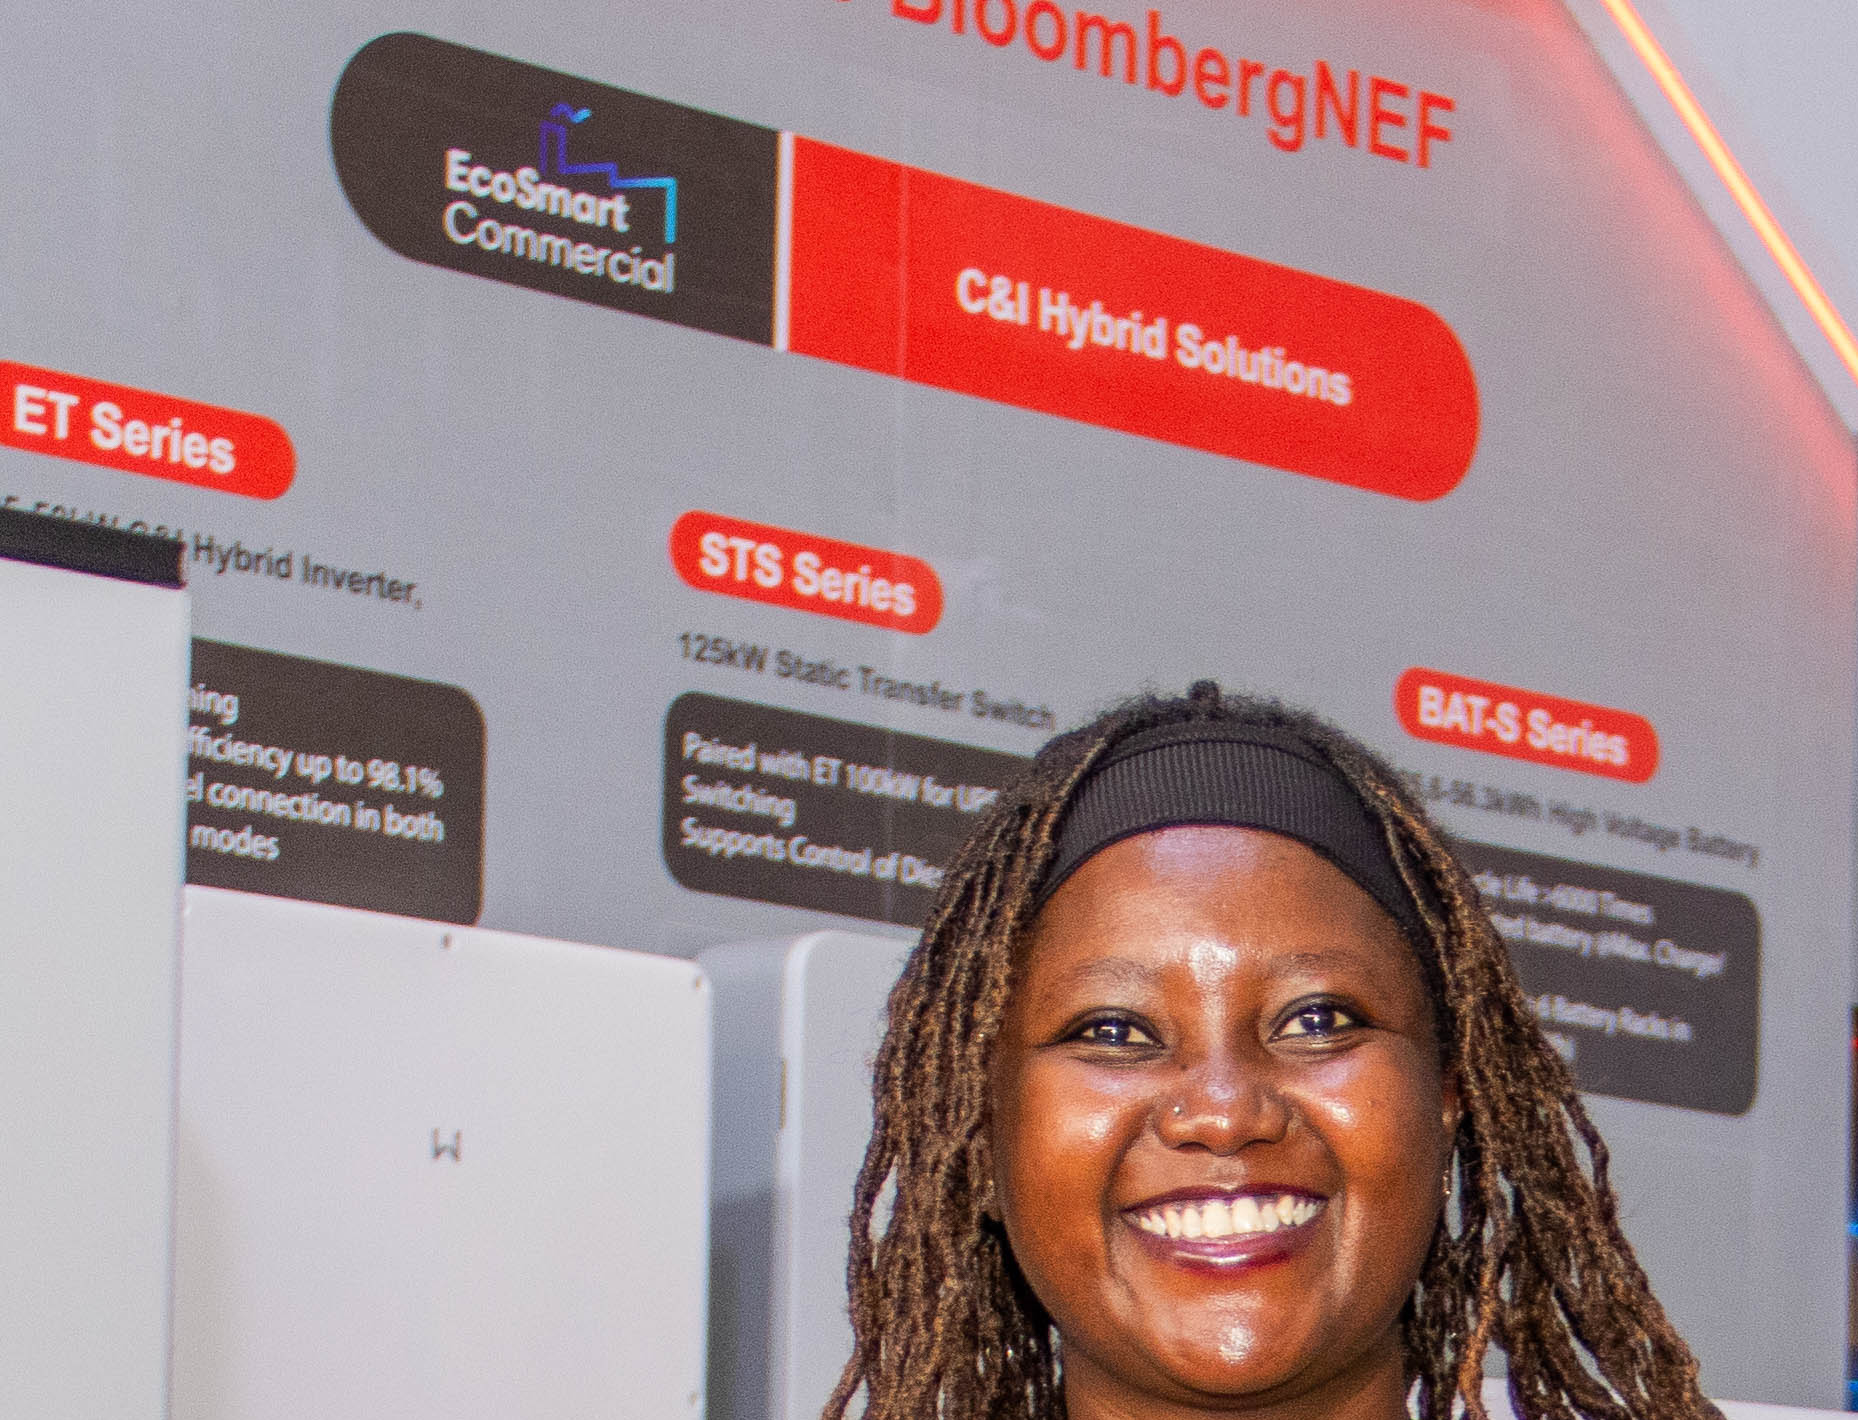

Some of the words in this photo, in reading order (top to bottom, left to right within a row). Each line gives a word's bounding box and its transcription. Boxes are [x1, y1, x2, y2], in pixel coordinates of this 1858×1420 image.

[891, 0, 1457, 169] oombergNEF
[444, 147, 630, 233] EcoSmart
[443, 200, 676, 294] Commercial
[956, 268, 1030, 326] C&I
[1038, 288, 1168, 361] Hybrid
[1177, 323, 1354, 407] Solutions
[13, 384, 79, 439] ET
[90, 401, 237, 475] Series
[193, 532, 293, 580] Hybrid
[303, 553, 424, 610] Inverter,
[699, 530, 784, 589] STS
[792, 550, 918, 618] Series
[677, 631, 769, 674] 125kW
[773, 648, 852, 691] Static
[857, 664, 965, 713] Transfer
[969, 688, 1057, 732] Switch
[1417, 685, 1524, 744] BAT-S
[1525, 708, 1631, 767] Series
[296, 752, 333, 785] up
[335, 754, 366, 785] to
[366, 757, 447, 799] 98.1%
[682, 731, 758, 772] Paired
[759, 751, 810, 781] with
[810, 755, 844, 786] ET
[920, 776, 955, 807] for
[682, 773, 798, 828] Switching
[189, 822, 282, 861] modes
[206, 781, 352, 828] connection
[353, 799, 383, 832] in
[383, 803, 446, 842] both
[681, 816, 787, 862] Supports
[787, 833, 874, 877] Control
[872, 851, 899, 880] of
